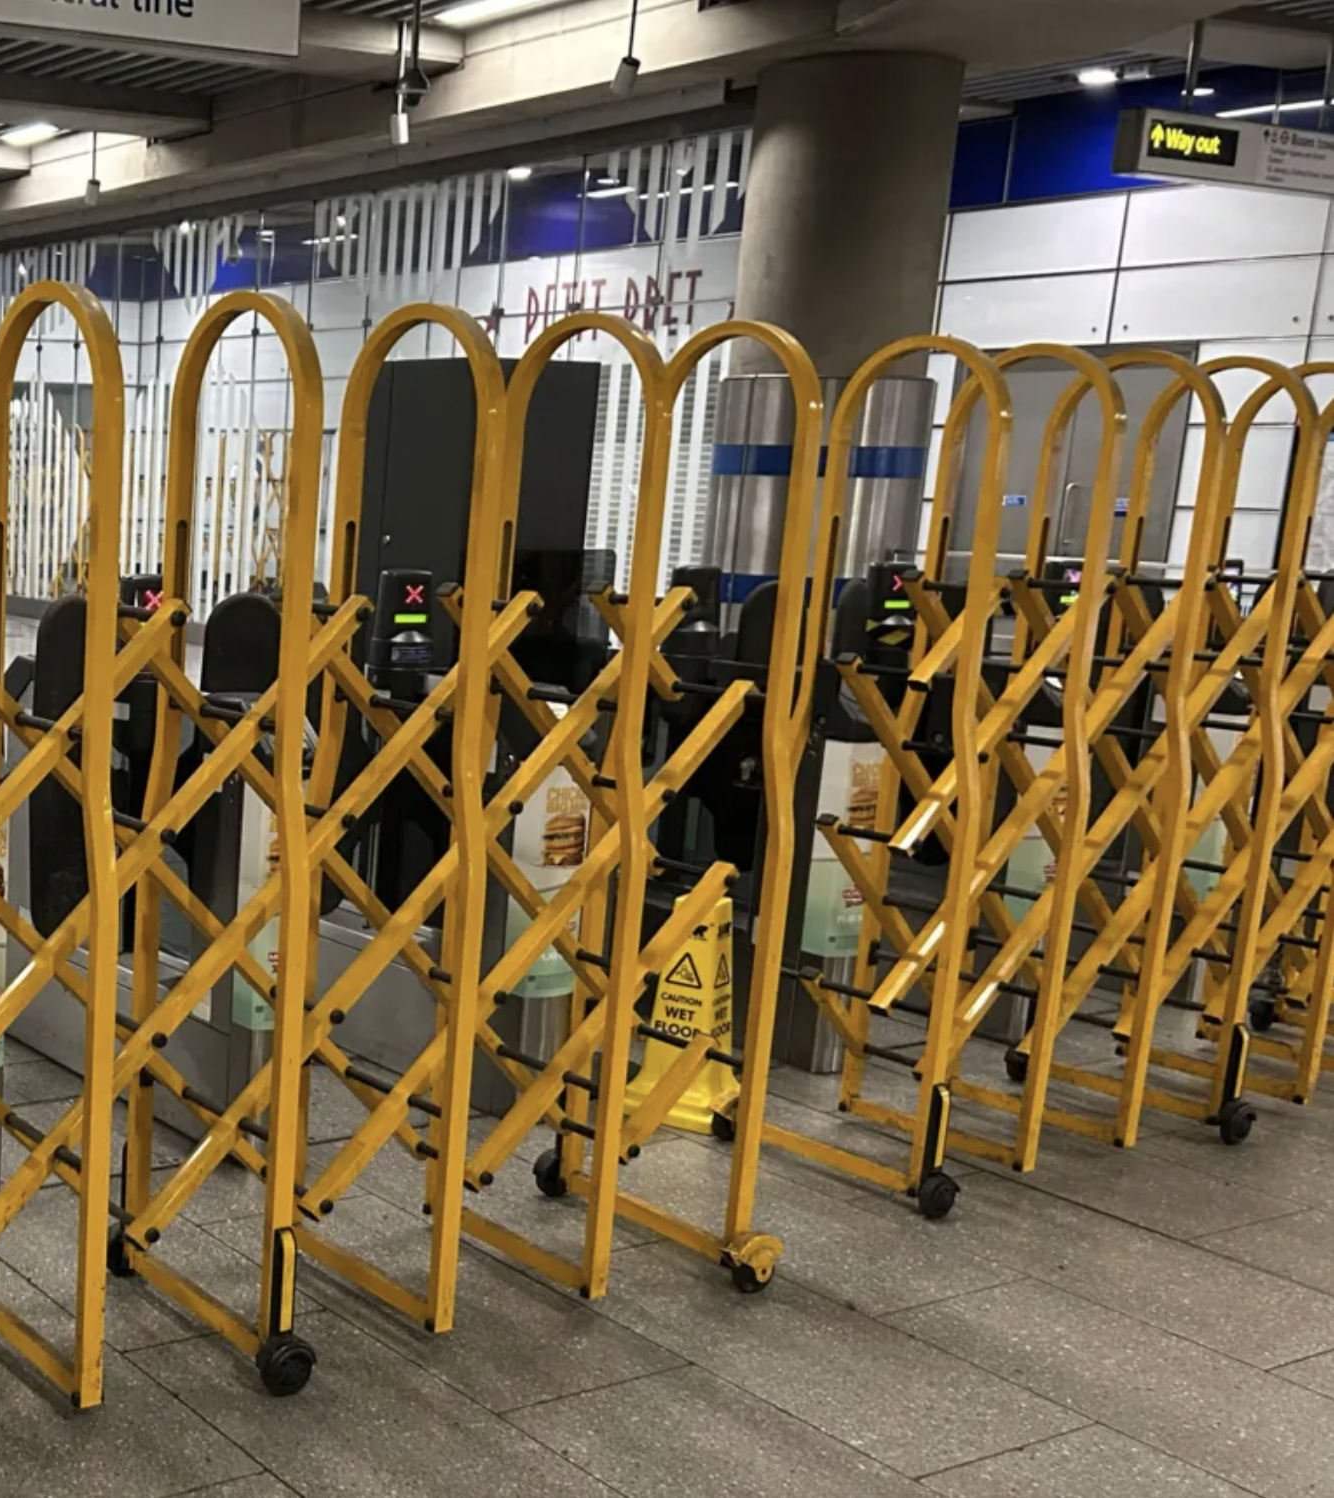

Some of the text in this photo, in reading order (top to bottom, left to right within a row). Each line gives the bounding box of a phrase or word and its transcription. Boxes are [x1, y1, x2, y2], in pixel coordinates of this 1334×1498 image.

[1166, 127, 1221, 156] Way out
[660, 992, 702, 1007] CAUTION
[665, 1004, 695, 1022] WET
